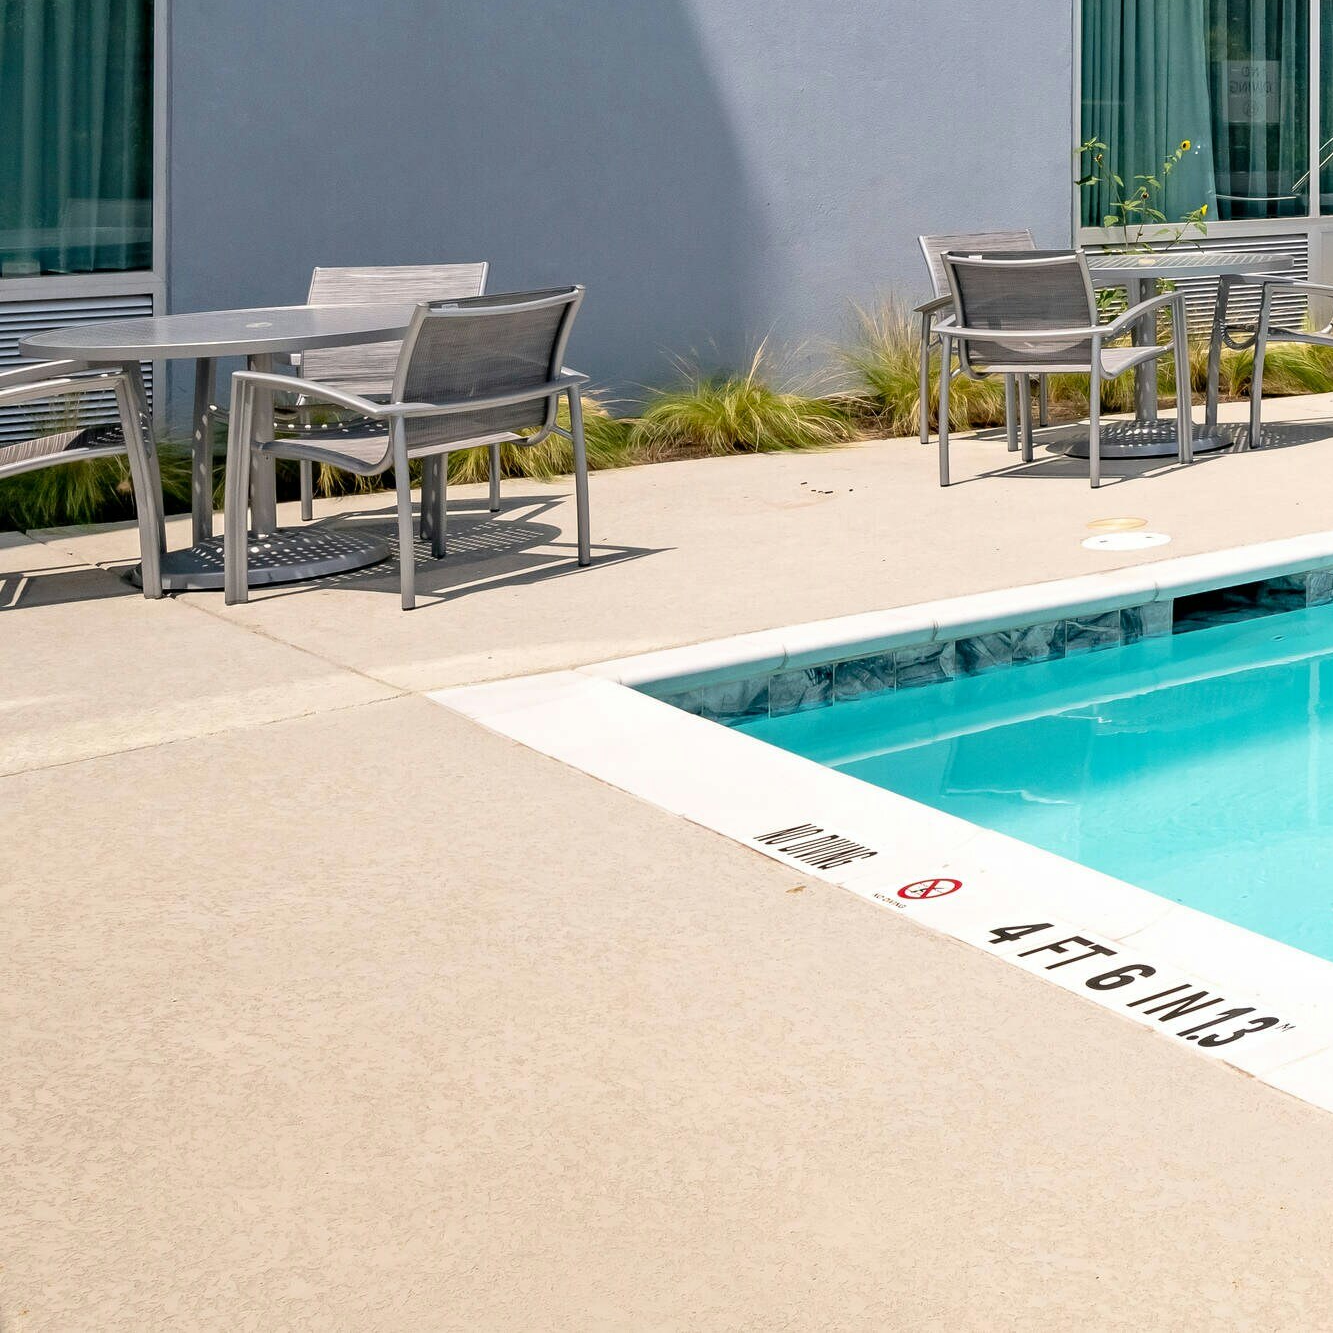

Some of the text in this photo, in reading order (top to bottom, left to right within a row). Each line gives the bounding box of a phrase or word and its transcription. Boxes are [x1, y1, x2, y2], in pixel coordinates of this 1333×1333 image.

[753, 823, 879, 870] NO DIVING
[988, 922, 1056, 945] 4
[1017, 935, 1119, 970] FT
[1085, 964, 1157, 991] 6
[1126, 983, 1226, 1022] IN
